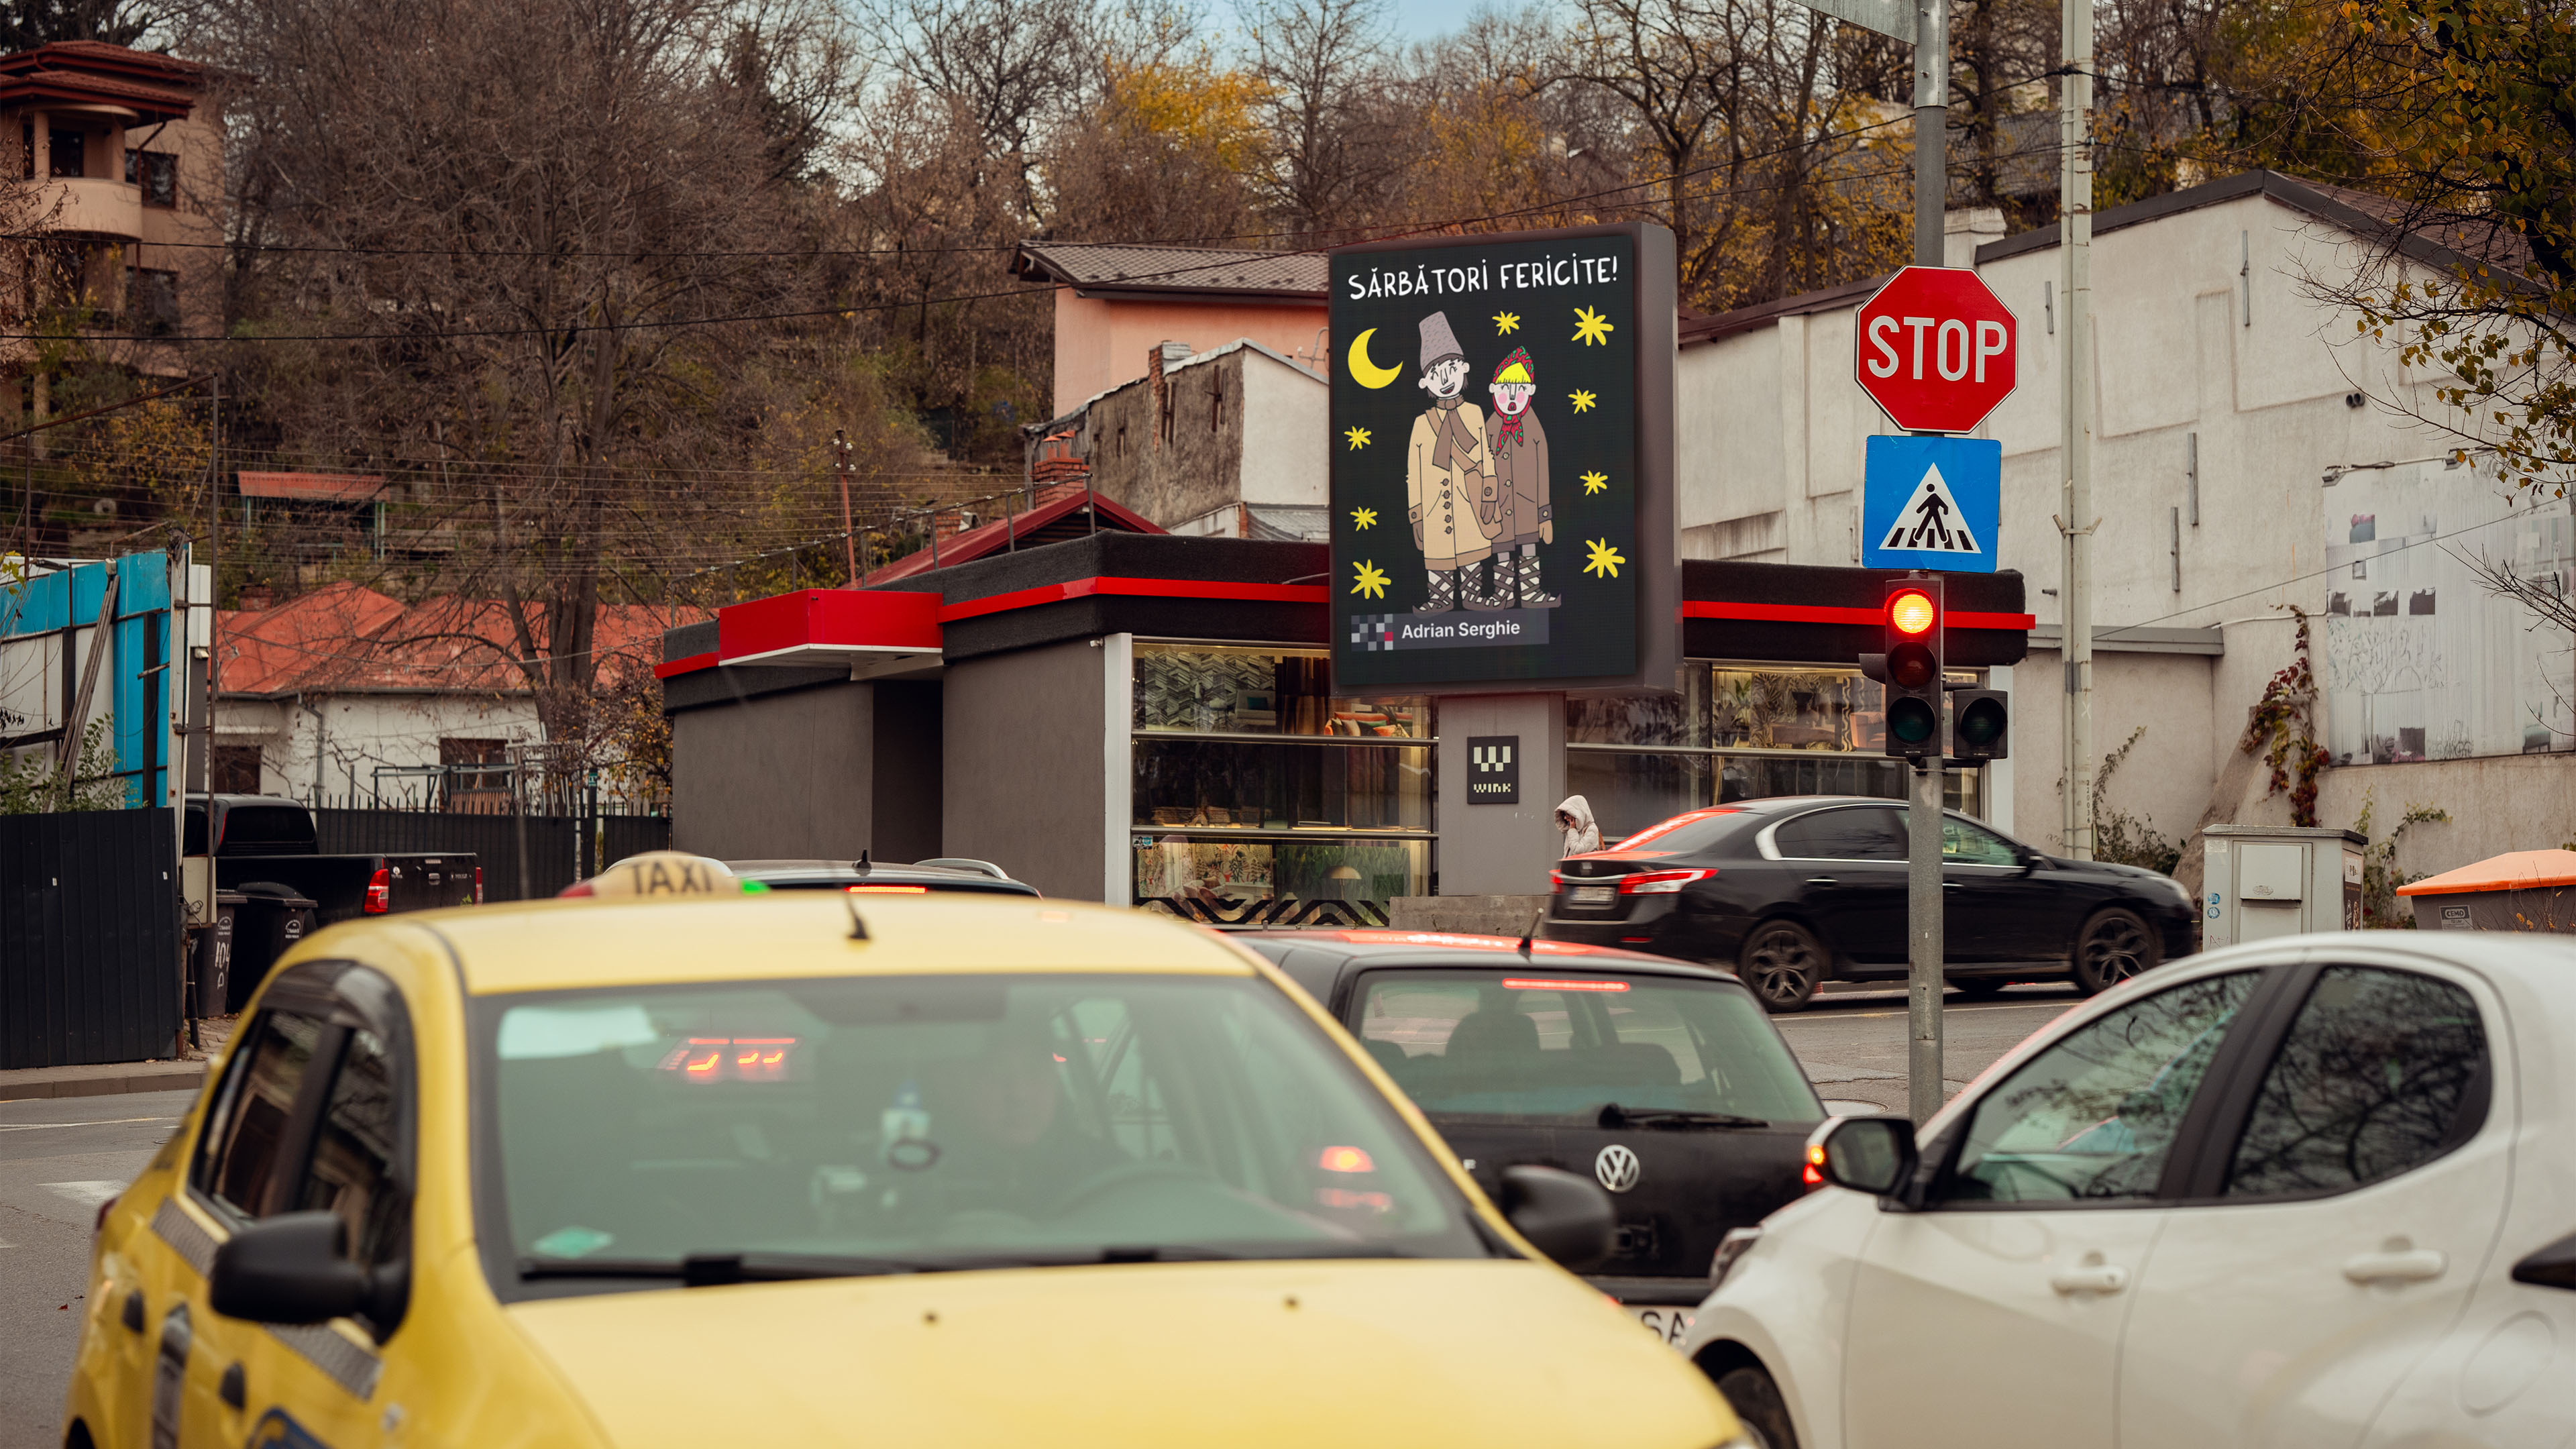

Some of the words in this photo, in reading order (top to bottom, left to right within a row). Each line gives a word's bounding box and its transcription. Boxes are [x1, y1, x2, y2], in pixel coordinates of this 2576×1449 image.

[1868, 315, 2008, 383] STOP
[1401, 625, 1454, 639] Adrian
[1458, 621, 1521, 639] Serghie
[629, 859, 712, 895] TAXI
[215, 941, 230, 972] 104
